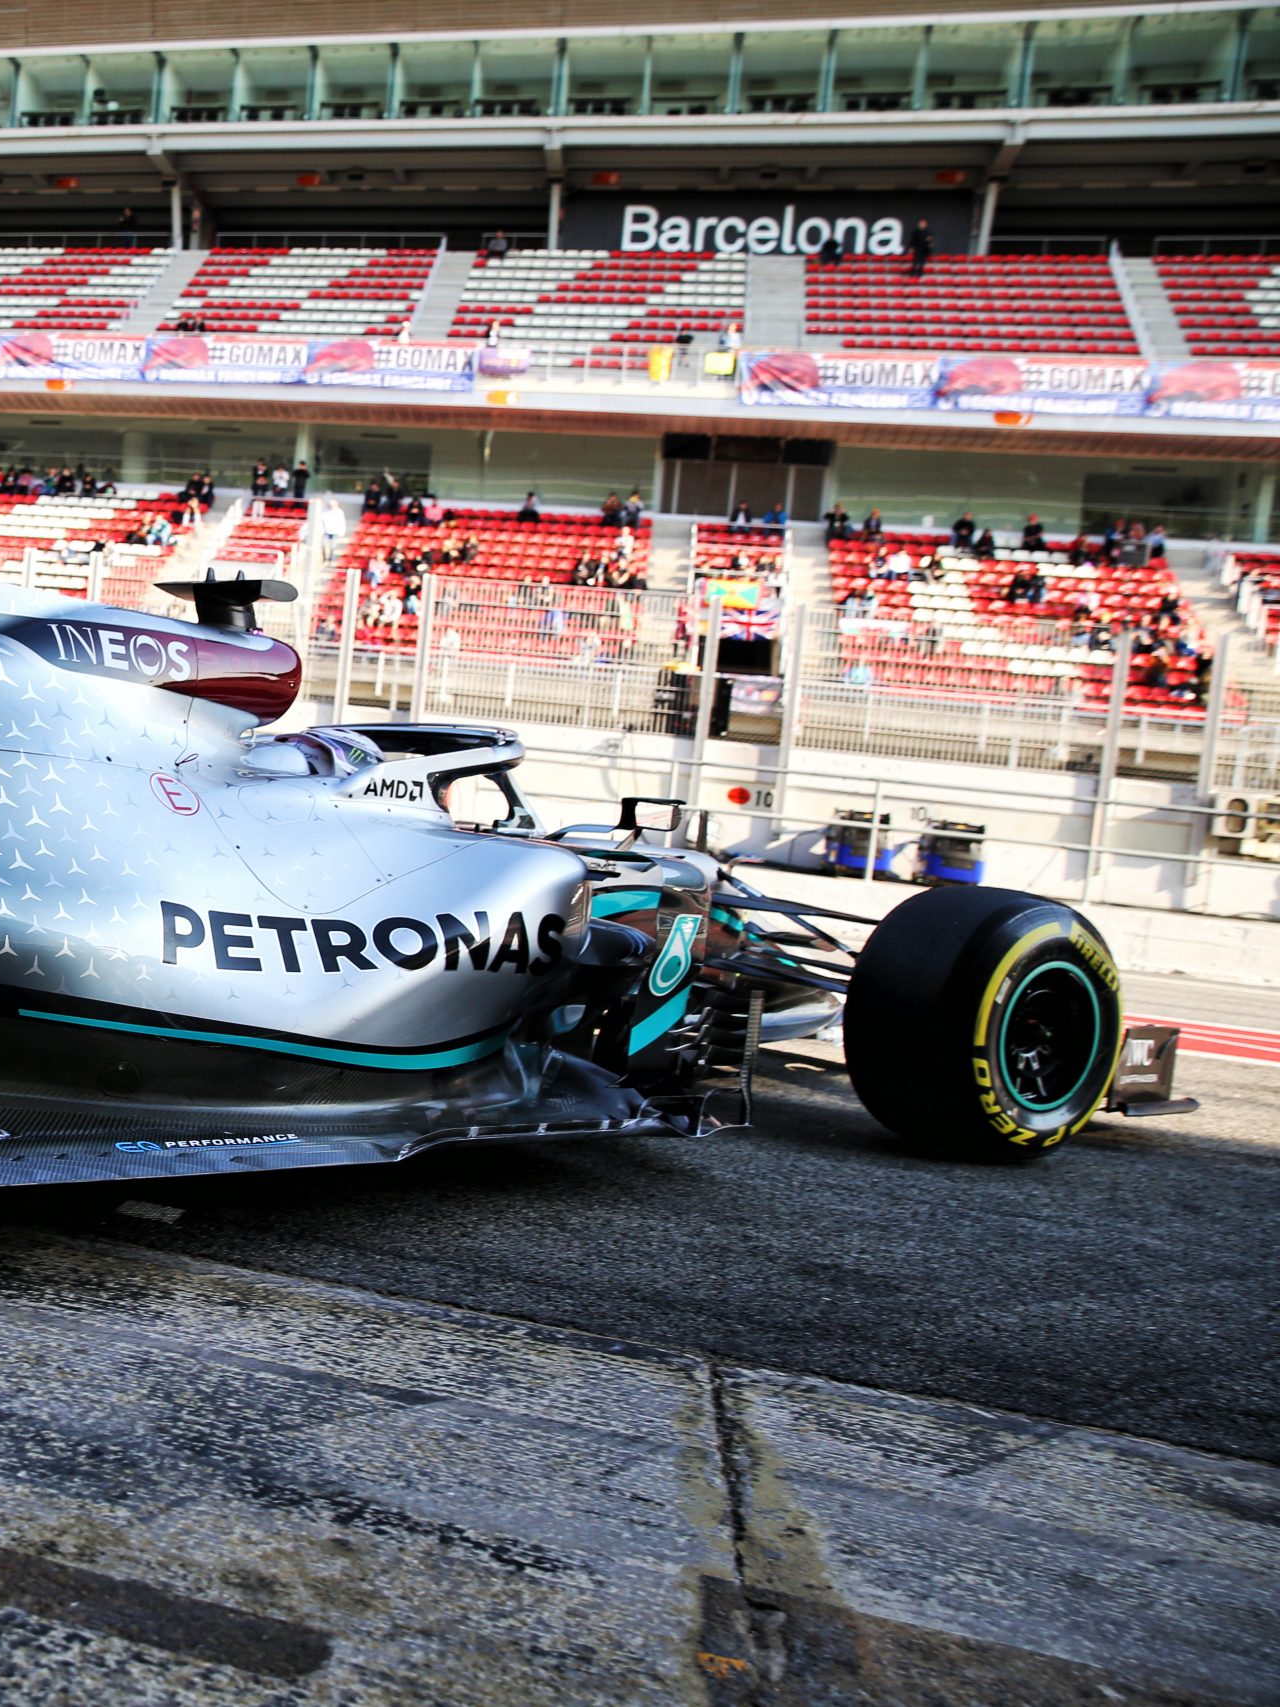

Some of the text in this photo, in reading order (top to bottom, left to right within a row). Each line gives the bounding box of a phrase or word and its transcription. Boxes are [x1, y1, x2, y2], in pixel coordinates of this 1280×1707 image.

[621, 204, 905, 254] Barcelona
[53, 341, 145, 363] #GOMAX
[208, 344, 304, 366] #GOMAX
[373, 347, 475, 371] #GOMAX
[820, 362, 936, 386] #GOMAX
[1021, 366, 1147, 392] #GOMAX
[47, 624, 192, 682] INEOS
[363, 778, 408, 799] AMD
[754, 789, 774, 807] 10
[160, 901, 567, 976] PETRONAS
[1069, 920, 1121, 994] PIRELLI
[972, 1057, 1039, 1146] ZERO
[114, 1133, 298, 1153] EQ PERFORMANCE
